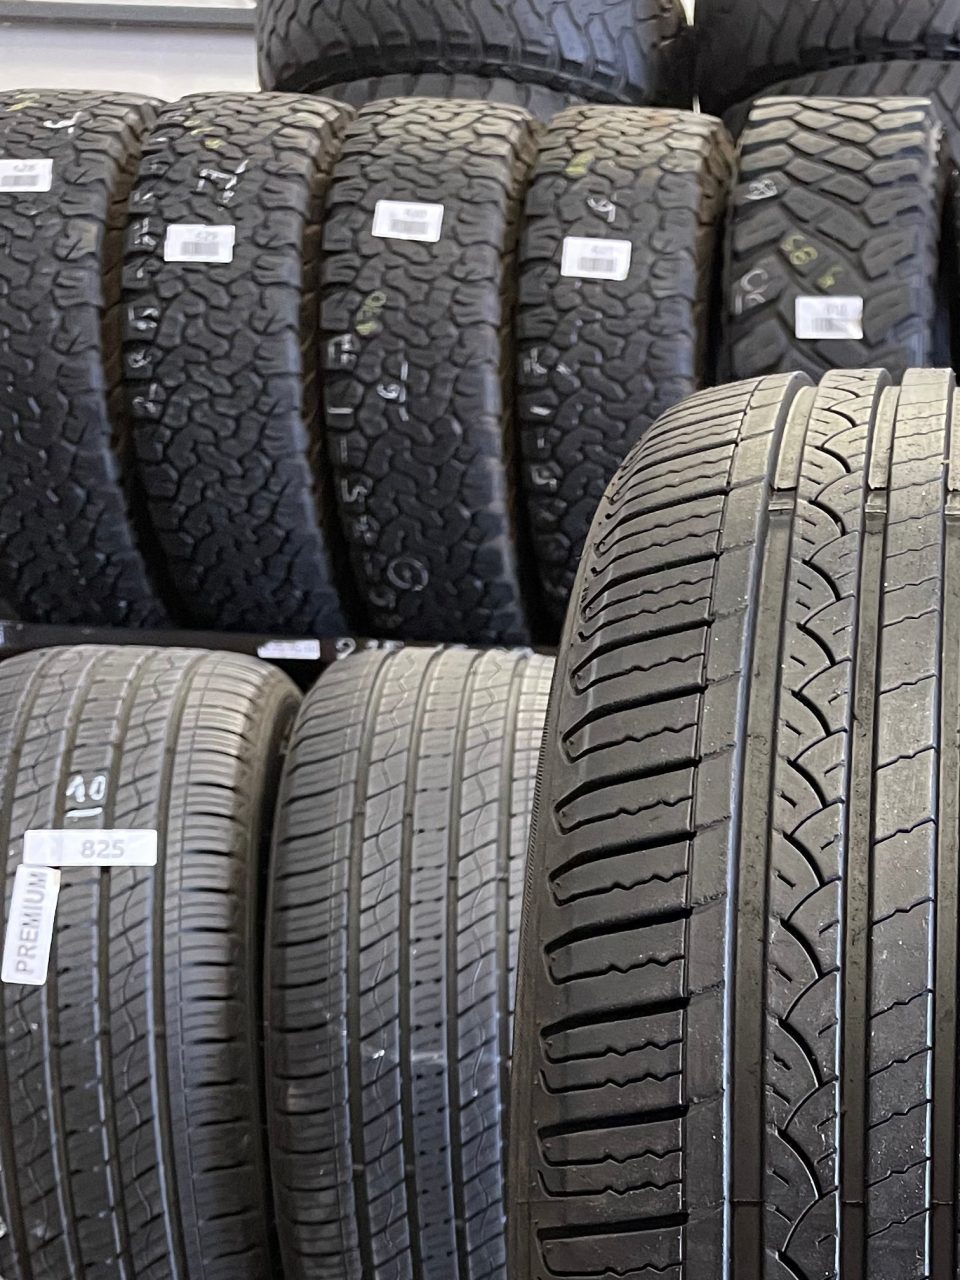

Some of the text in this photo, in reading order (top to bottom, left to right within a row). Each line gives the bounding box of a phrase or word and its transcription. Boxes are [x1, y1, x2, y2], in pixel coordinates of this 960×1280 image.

[65, 774, 106, 803] 10
[80, 839, 125, 859] 825
[15, 870, 48, 975] PREMIUM
